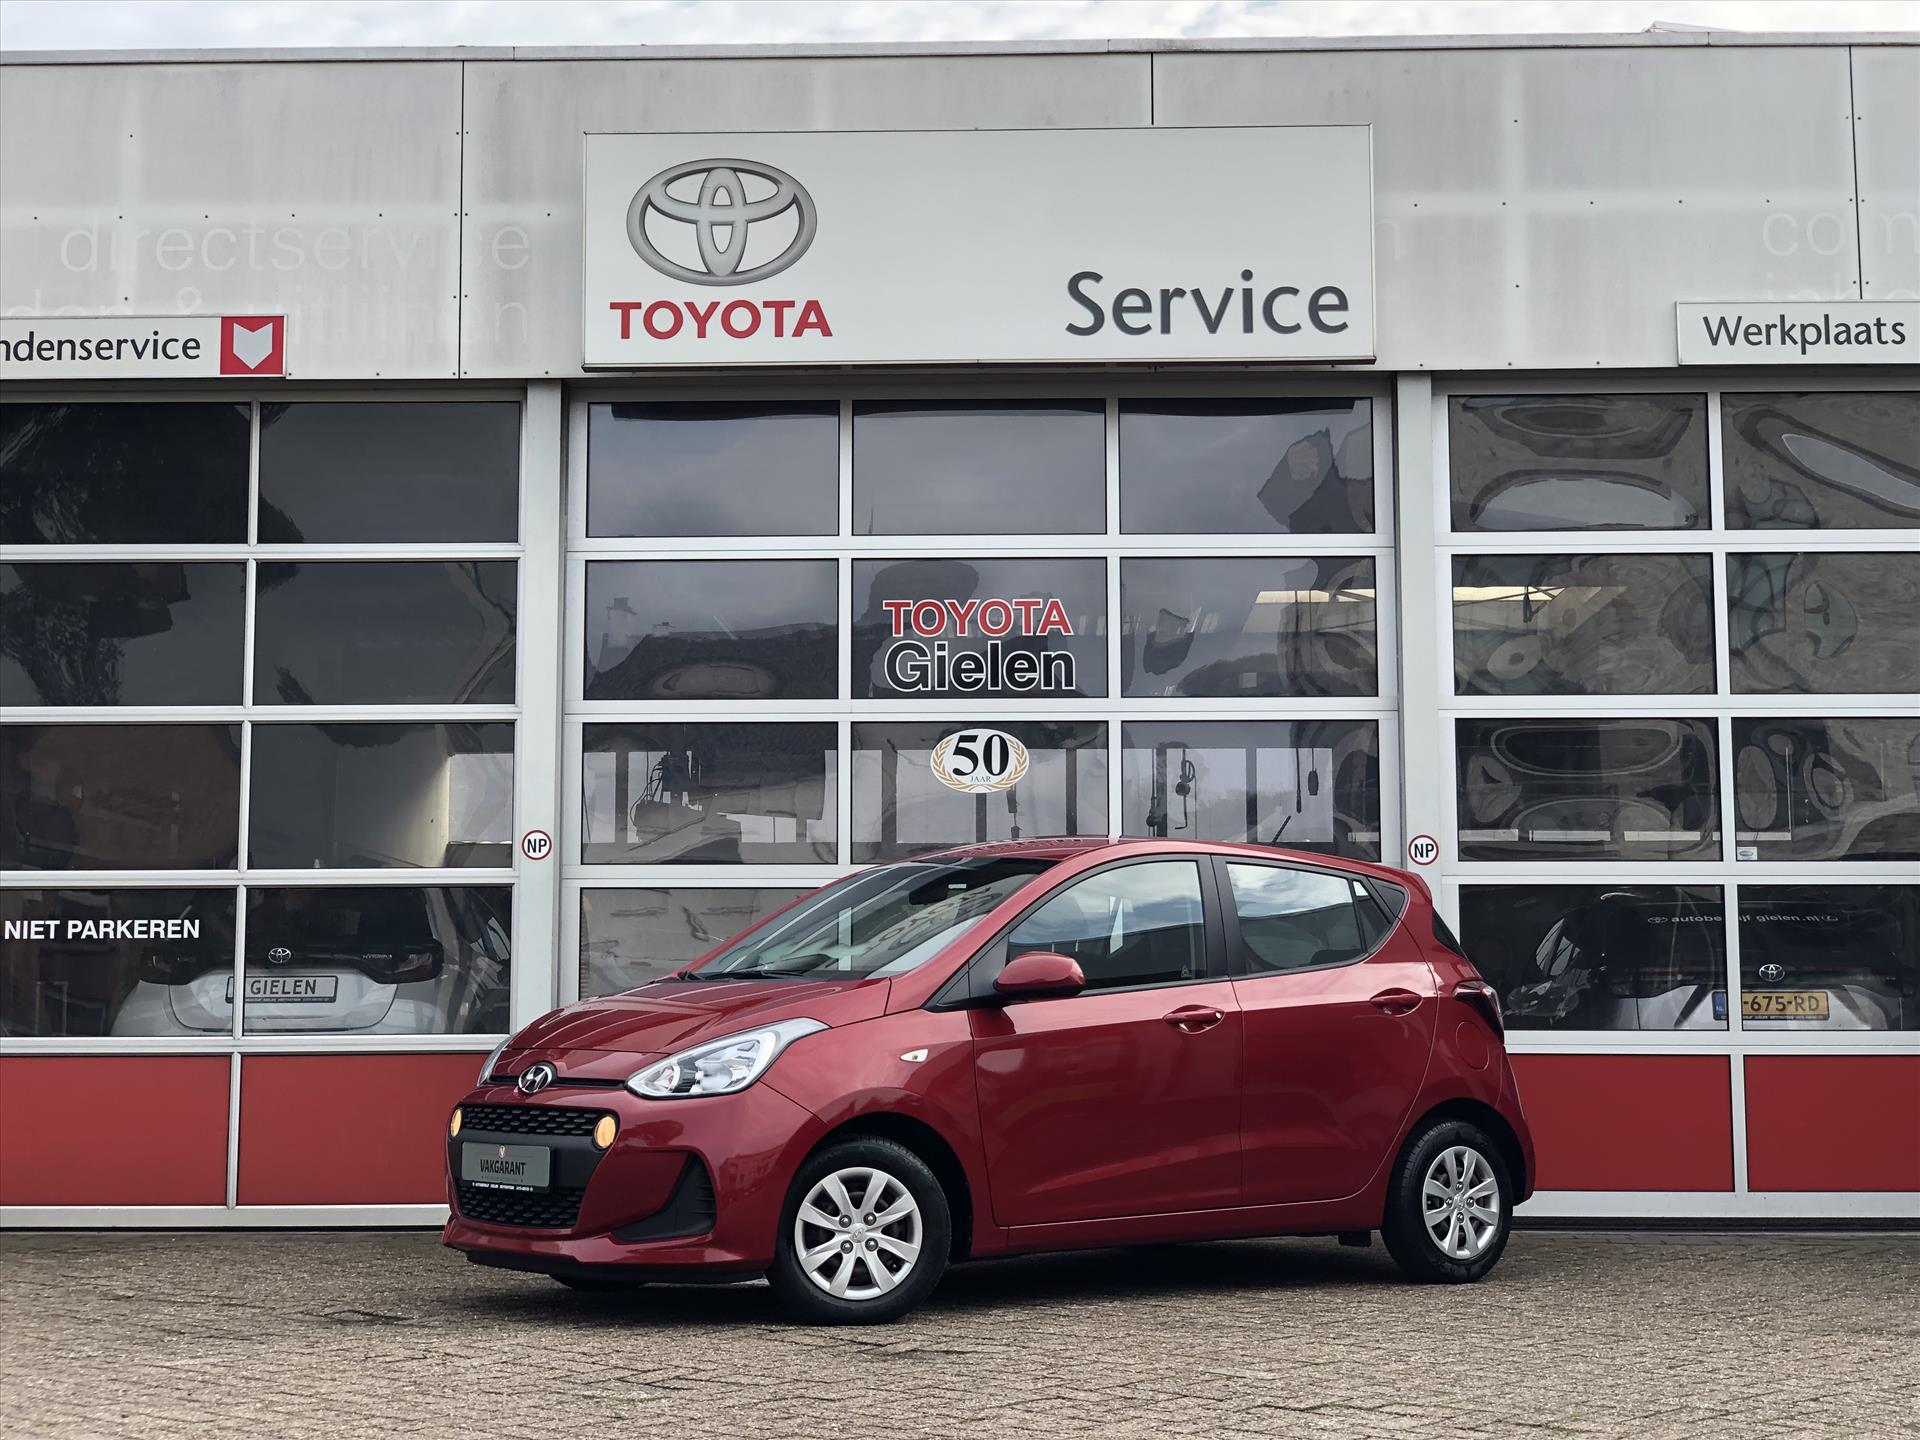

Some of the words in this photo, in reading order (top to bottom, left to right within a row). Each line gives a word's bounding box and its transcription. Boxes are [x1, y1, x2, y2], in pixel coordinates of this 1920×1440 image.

[60, 216, 530, 273] directservie
[1065, 269, 1349, 336] Service
[609, 299, 833, 340] TOYOTA
[0, 330, 201, 362] ndenservice
[1703, 314, 1906, 354] Werkplaats
[883, 598, 1074, 638] TOYOTA
[884, 640, 1076, 692] Gielen
[951, 733, 1010, 777] 50
[969, 775, 992, 784] JAAR
[527, 838, 548, 854] NP
[1414, 843, 1435, 859] NP
[4, 919, 61, 941] NIET
[67, 918, 200, 940] PARKEREN
[1671, 914, 1752, 924] autobeijf
[250, 978, 317, 996] GIELEN
[1743, 995, 1820, 1012] -675-RD
[480, 1159, 526, 1175] VAKGARANT
